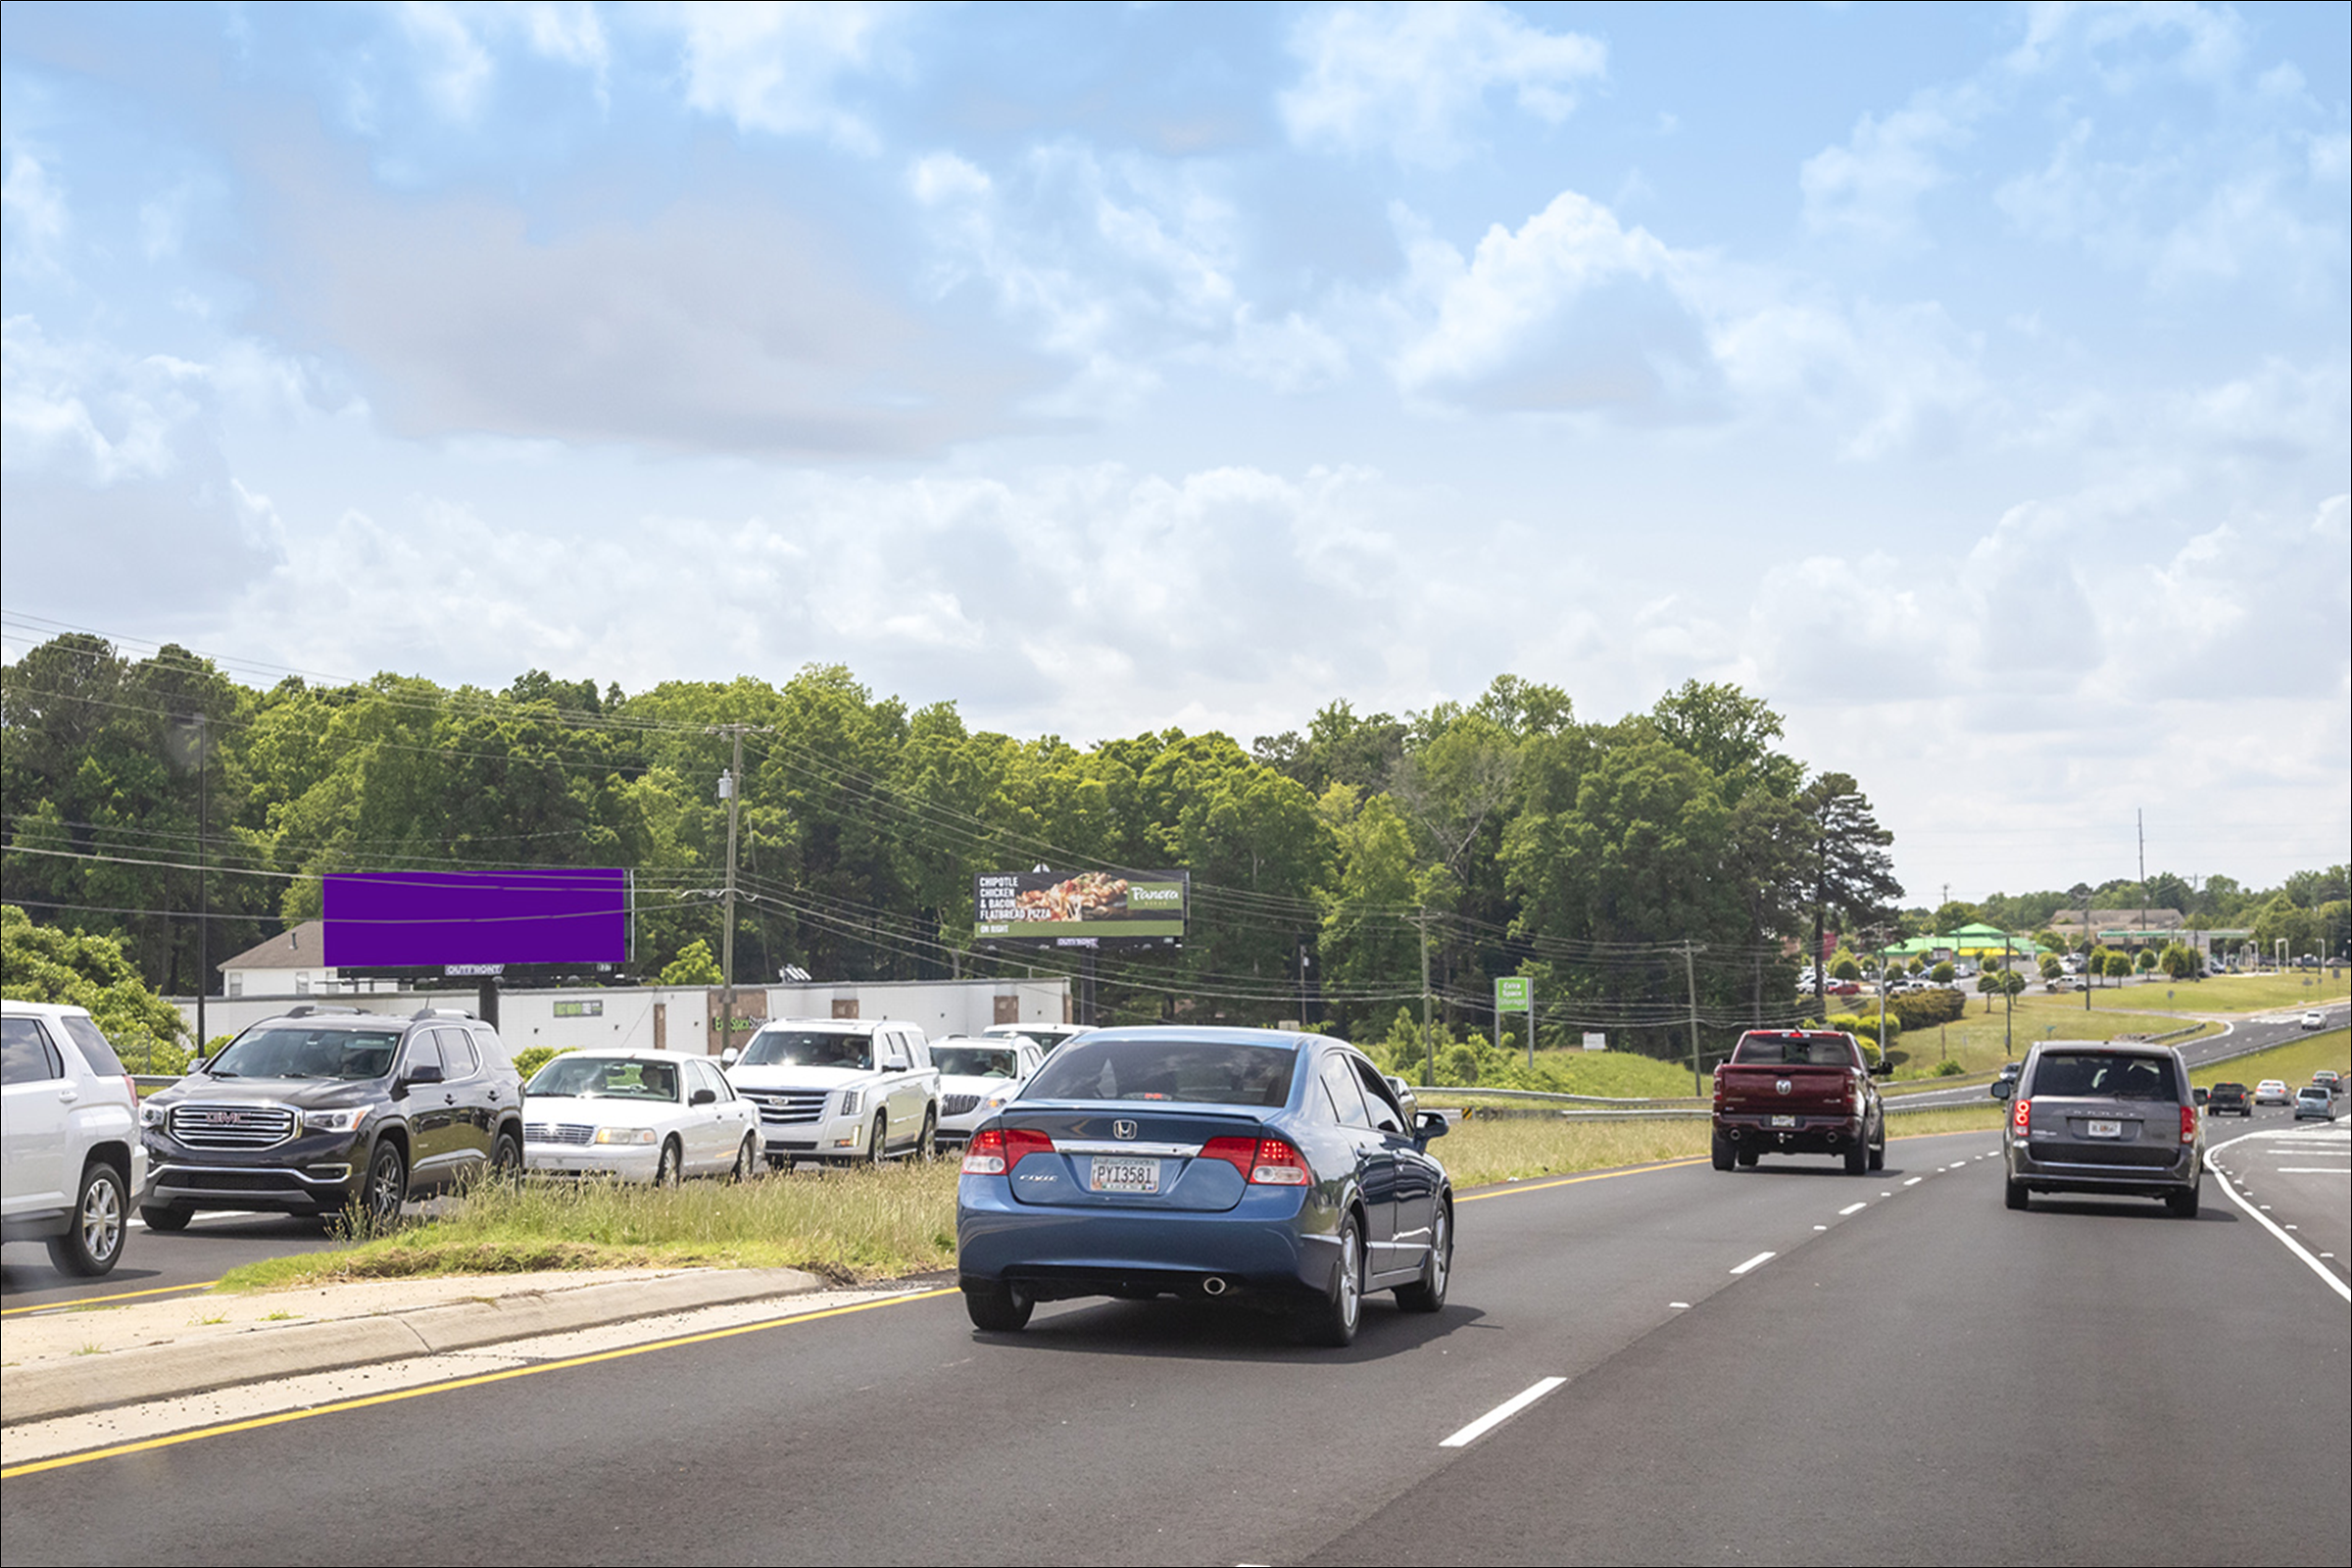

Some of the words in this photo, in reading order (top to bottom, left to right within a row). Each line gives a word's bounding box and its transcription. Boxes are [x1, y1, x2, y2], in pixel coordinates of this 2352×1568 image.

[979, 877, 1018, 888] CHIPOTLE
[979, 888, 1015, 898] CHICKEN
[1130, 886, 1179, 901] Panera
[980, 899, 987, 908] &
[989, 899, 1016, 908] BACON
[980, 909, 1026, 920] FLATBREAD
[1028, 908, 1052, 919] PIZZA
[447, 964, 502, 975] OUTFRONT
[206, 1111, 250, 1124] GMC
[1097, 1166, 1152, 1184] PYI3581
